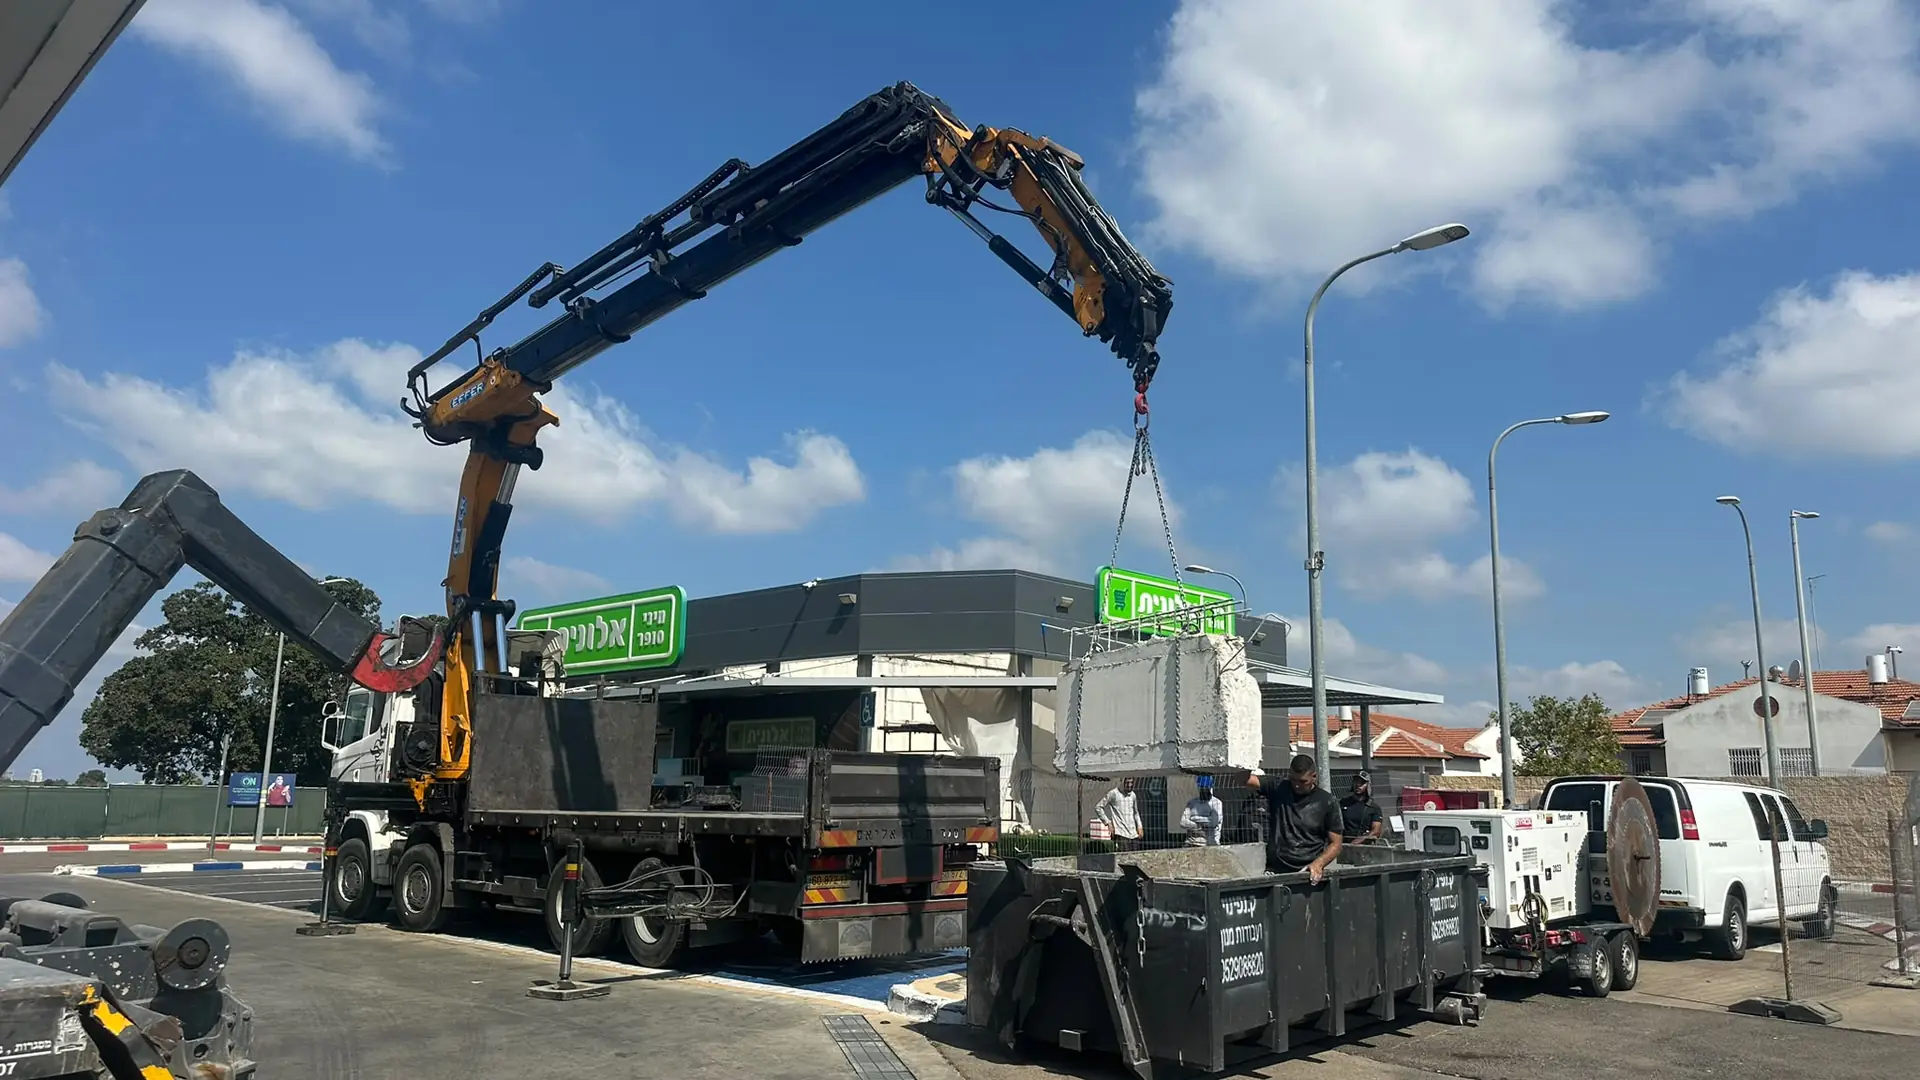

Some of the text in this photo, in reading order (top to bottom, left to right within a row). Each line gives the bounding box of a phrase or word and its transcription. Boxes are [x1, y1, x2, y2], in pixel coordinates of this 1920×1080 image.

[451, 382, 484, 408] EFFER
[642, 610, 666, 626] מיני
[637, 630, 665, 647] סופר
